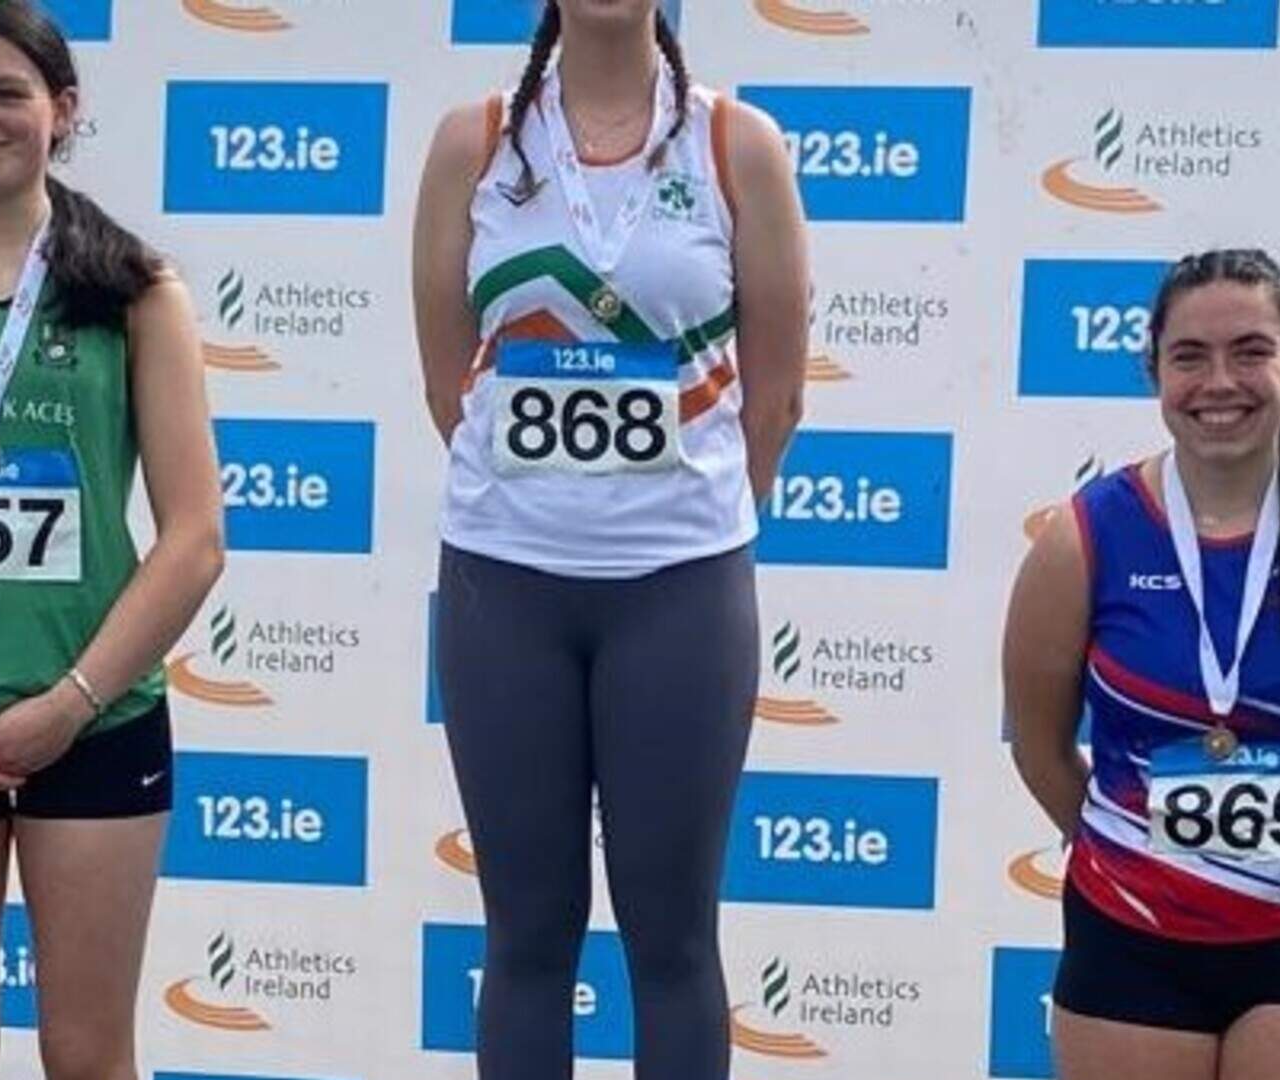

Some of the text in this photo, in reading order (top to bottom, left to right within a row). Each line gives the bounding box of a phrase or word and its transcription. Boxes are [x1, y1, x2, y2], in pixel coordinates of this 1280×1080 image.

[210, 126, 340, 171] 123.ie
[1136, 123, 1261, 148] Athletics
[1135, 152, 1229, 177] Ireland
[256, 283, 370, 308] Athletics
[827, 292, 948, 319] Athletics
[255, 312, 343, 336] Ireland
[825, 320, 919, 346] Ireland
[553, 349, 616, 371] 123.ie
[507, 387, 667, 462] 868
[223, 464, 327, 508] 23.ie
[1129, 574, 1183, 590] KCS
[249, 620, 360, 647] Athletics
[247, 648, 334, 673] Ireland
[812, 638, 933, 664] Athletics
[811, 667, 905, 691] Ireland
[198, 797, 323, 842] 123.ie
[754, 816, 888, 864] 123.ie
[246, 948, 356, 974] Athletics
[245, 975, 331, 1000] Ireland
[801, 973, 920, 1000] Athletics
[801, 1001, 892, 1026] Ireland
